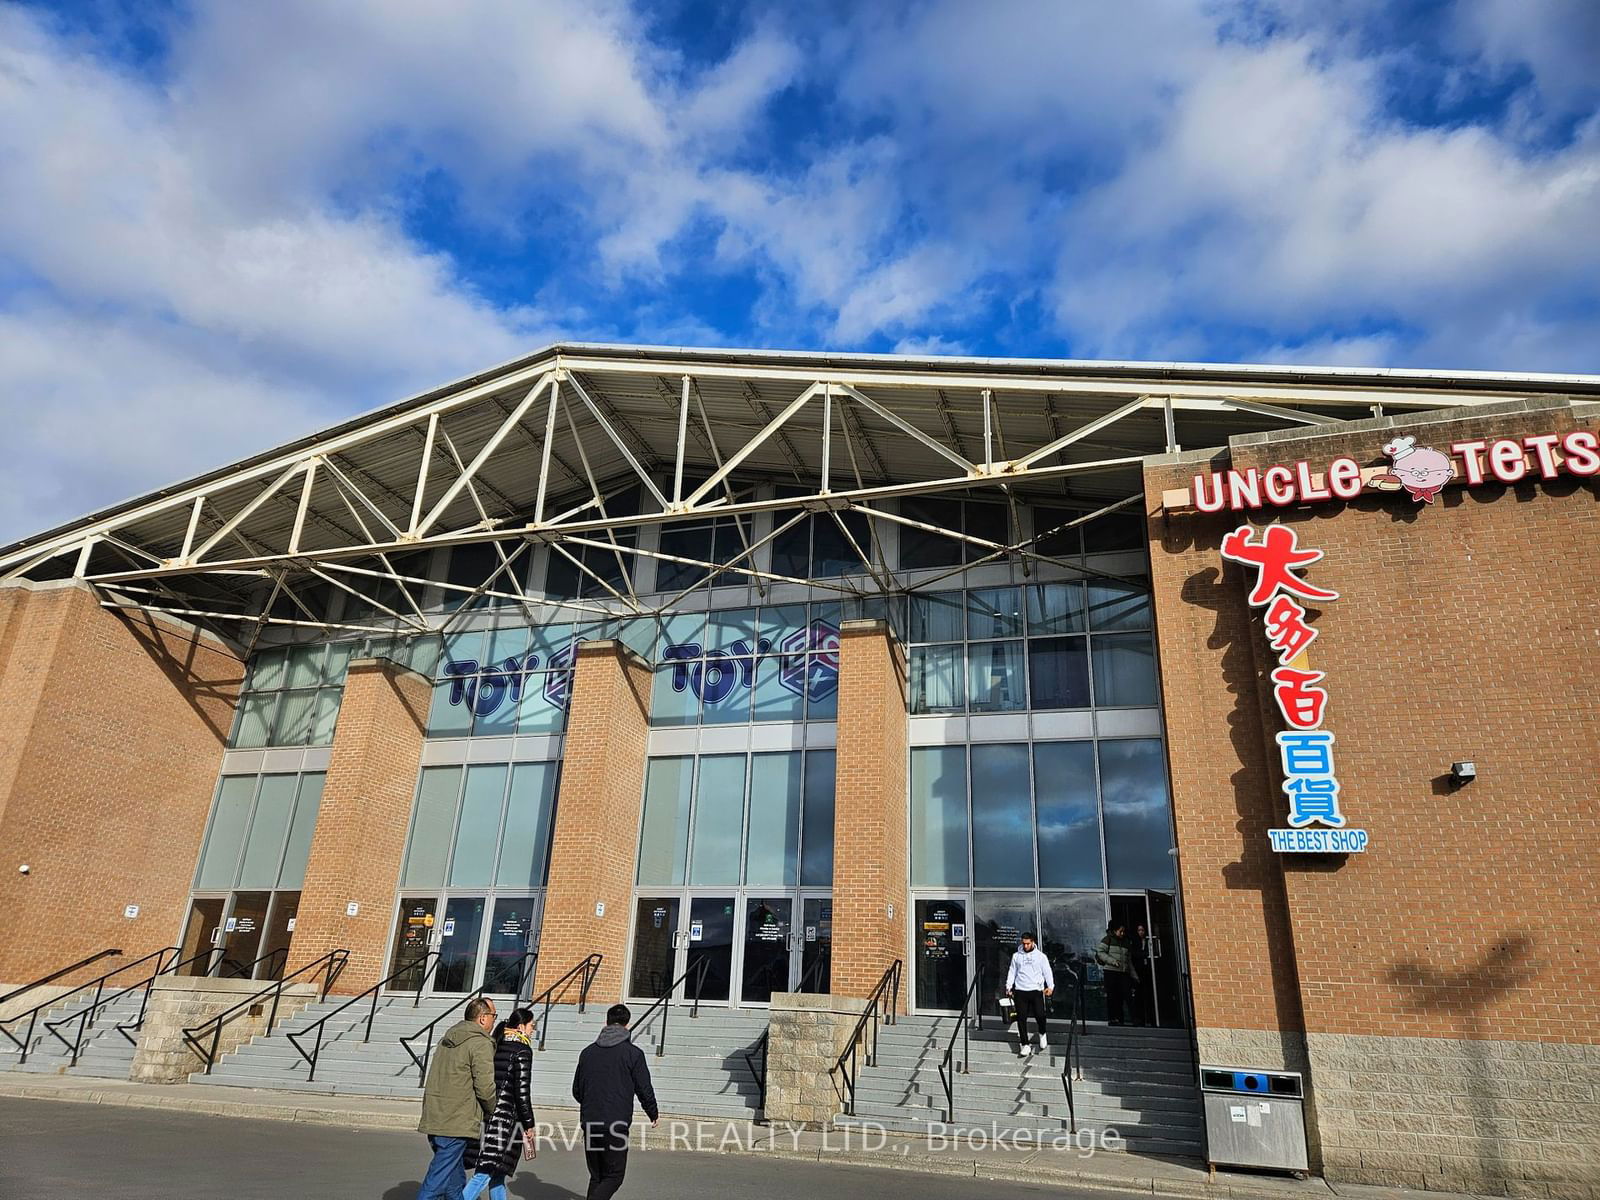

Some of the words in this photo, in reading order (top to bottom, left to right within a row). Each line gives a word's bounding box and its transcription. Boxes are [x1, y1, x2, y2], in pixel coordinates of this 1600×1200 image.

[444, 653, 540, 718] TOY
[662, 637, 773, 705] TOY
[1270, 831, 1295, 850] THE
[1296, 831, 1328, 850] BEST
[1331, 831, 1367, 850] SHOP
